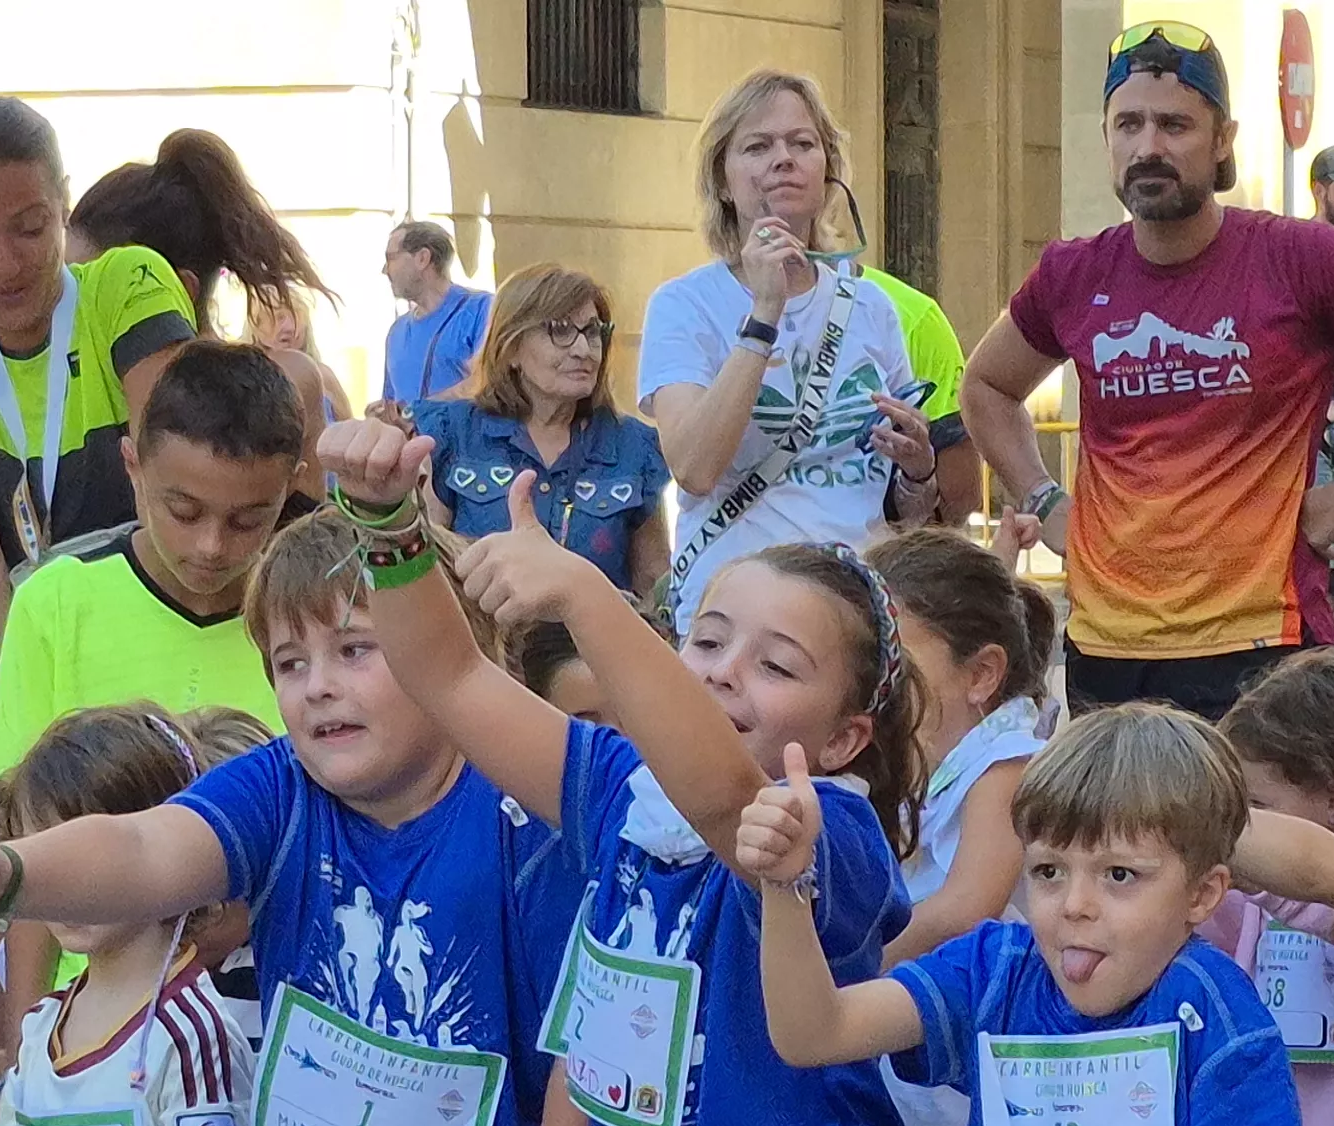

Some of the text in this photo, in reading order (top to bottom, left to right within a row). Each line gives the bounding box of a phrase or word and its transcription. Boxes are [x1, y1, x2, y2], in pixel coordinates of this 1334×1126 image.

[1100, 363, 1251, 399] HUESCA
[308, 1017, 372, 1060] CARRERA
[378, 1052, 460, 1081] INFANTIL
[1060, 1055, 1143, 1077] INFANTIL
